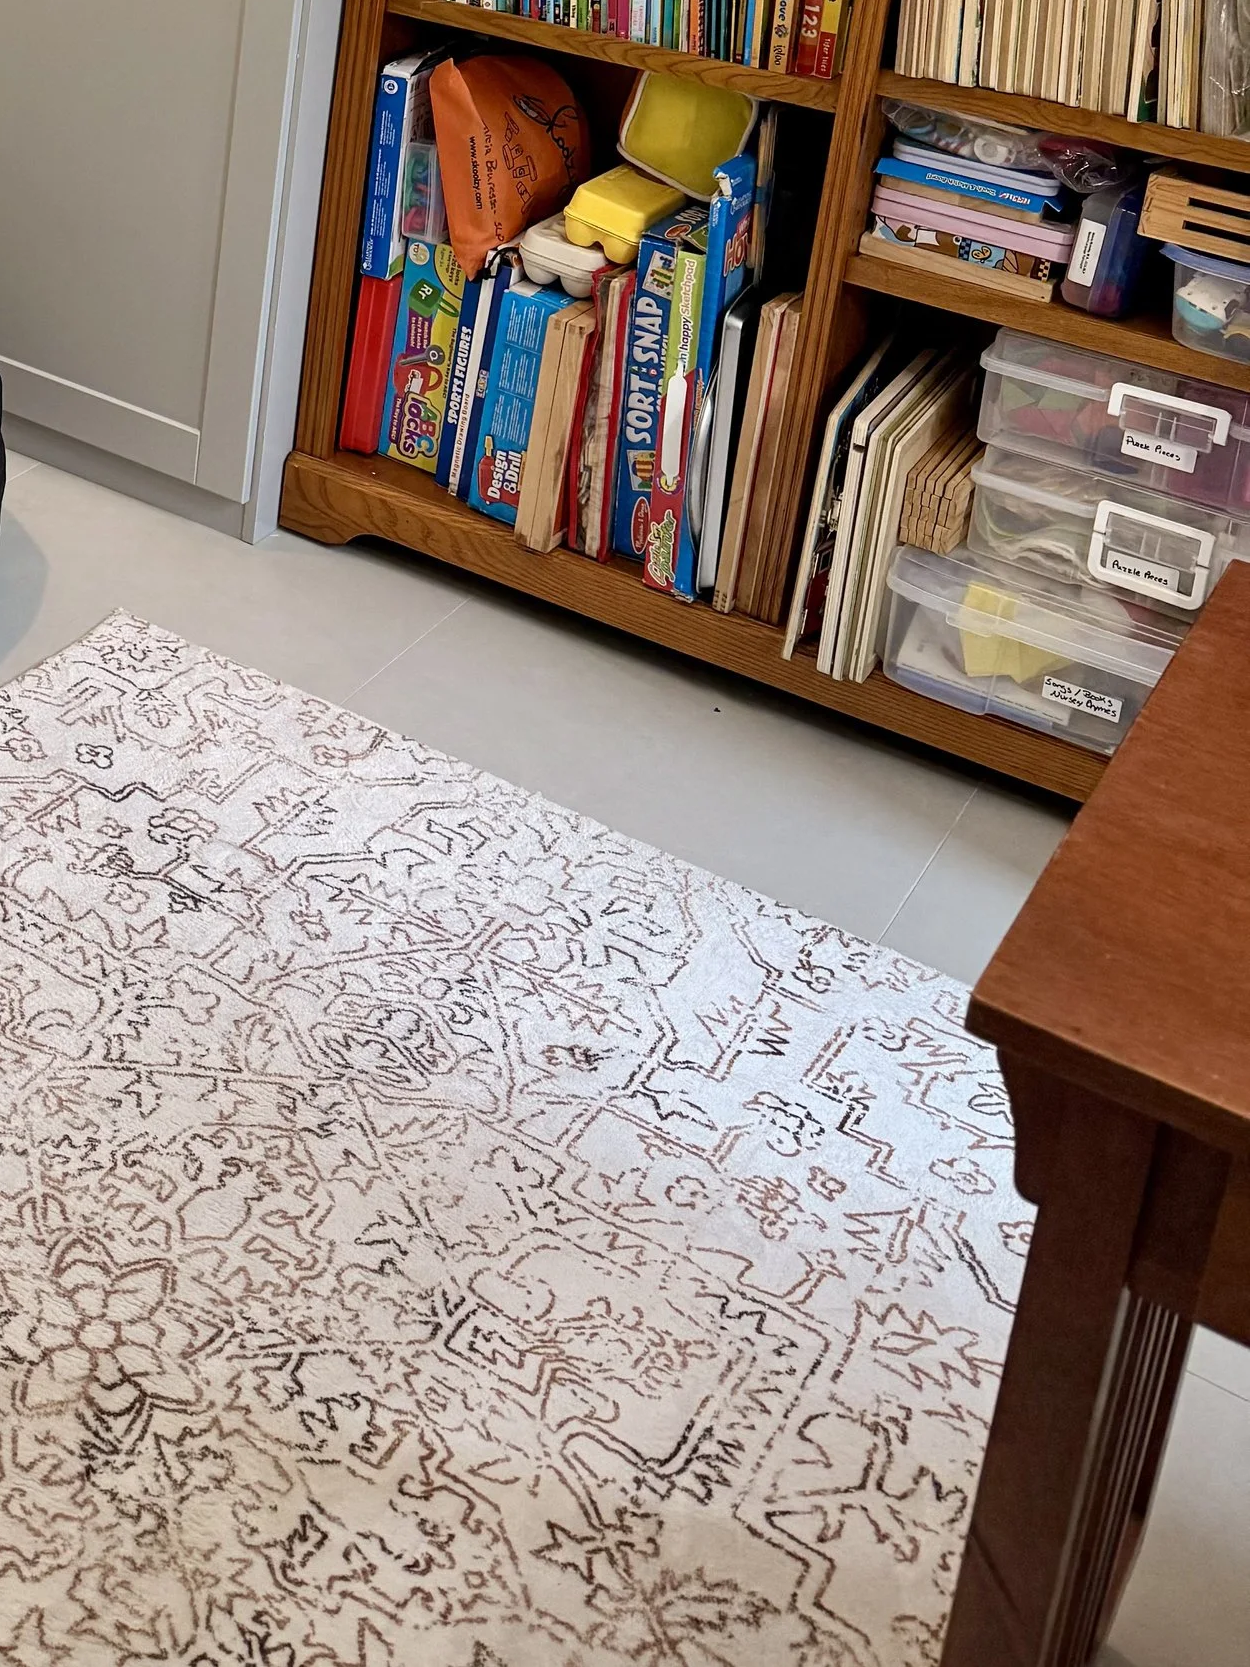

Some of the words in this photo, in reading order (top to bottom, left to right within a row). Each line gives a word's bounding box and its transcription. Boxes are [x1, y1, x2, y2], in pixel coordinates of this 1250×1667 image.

[773, 44, 787, 66] igloo
[469, 135, 483, 210] www.skoolzy.com
[418, 283, 433, 300] Rr
[679, 258, 697, 318] Sketchpad
[632, 296, 664, 364] SNAP
[679, 318, 694, 352] happy
[454, 326, 473, 377] FIGURES
[447, 378, 464, 426] SPORTS
[461, 393, 470, 415] Board
[625, 372, 655, 444] SORT
[403, 396, 428, 454] locks
[416, 402, 438, 453] ABC
[456, 415, 468, 444] Drawing
[451, 443, 463, 477] Magnetic
[488, 450, 508, 499] Design
[505, 451, 522, 483] Drill
[1112, 559, 1141, 579] Puzzle
[1044, 677, 1073, 695] Songs
[1082, 689, 1114, 707] Books
